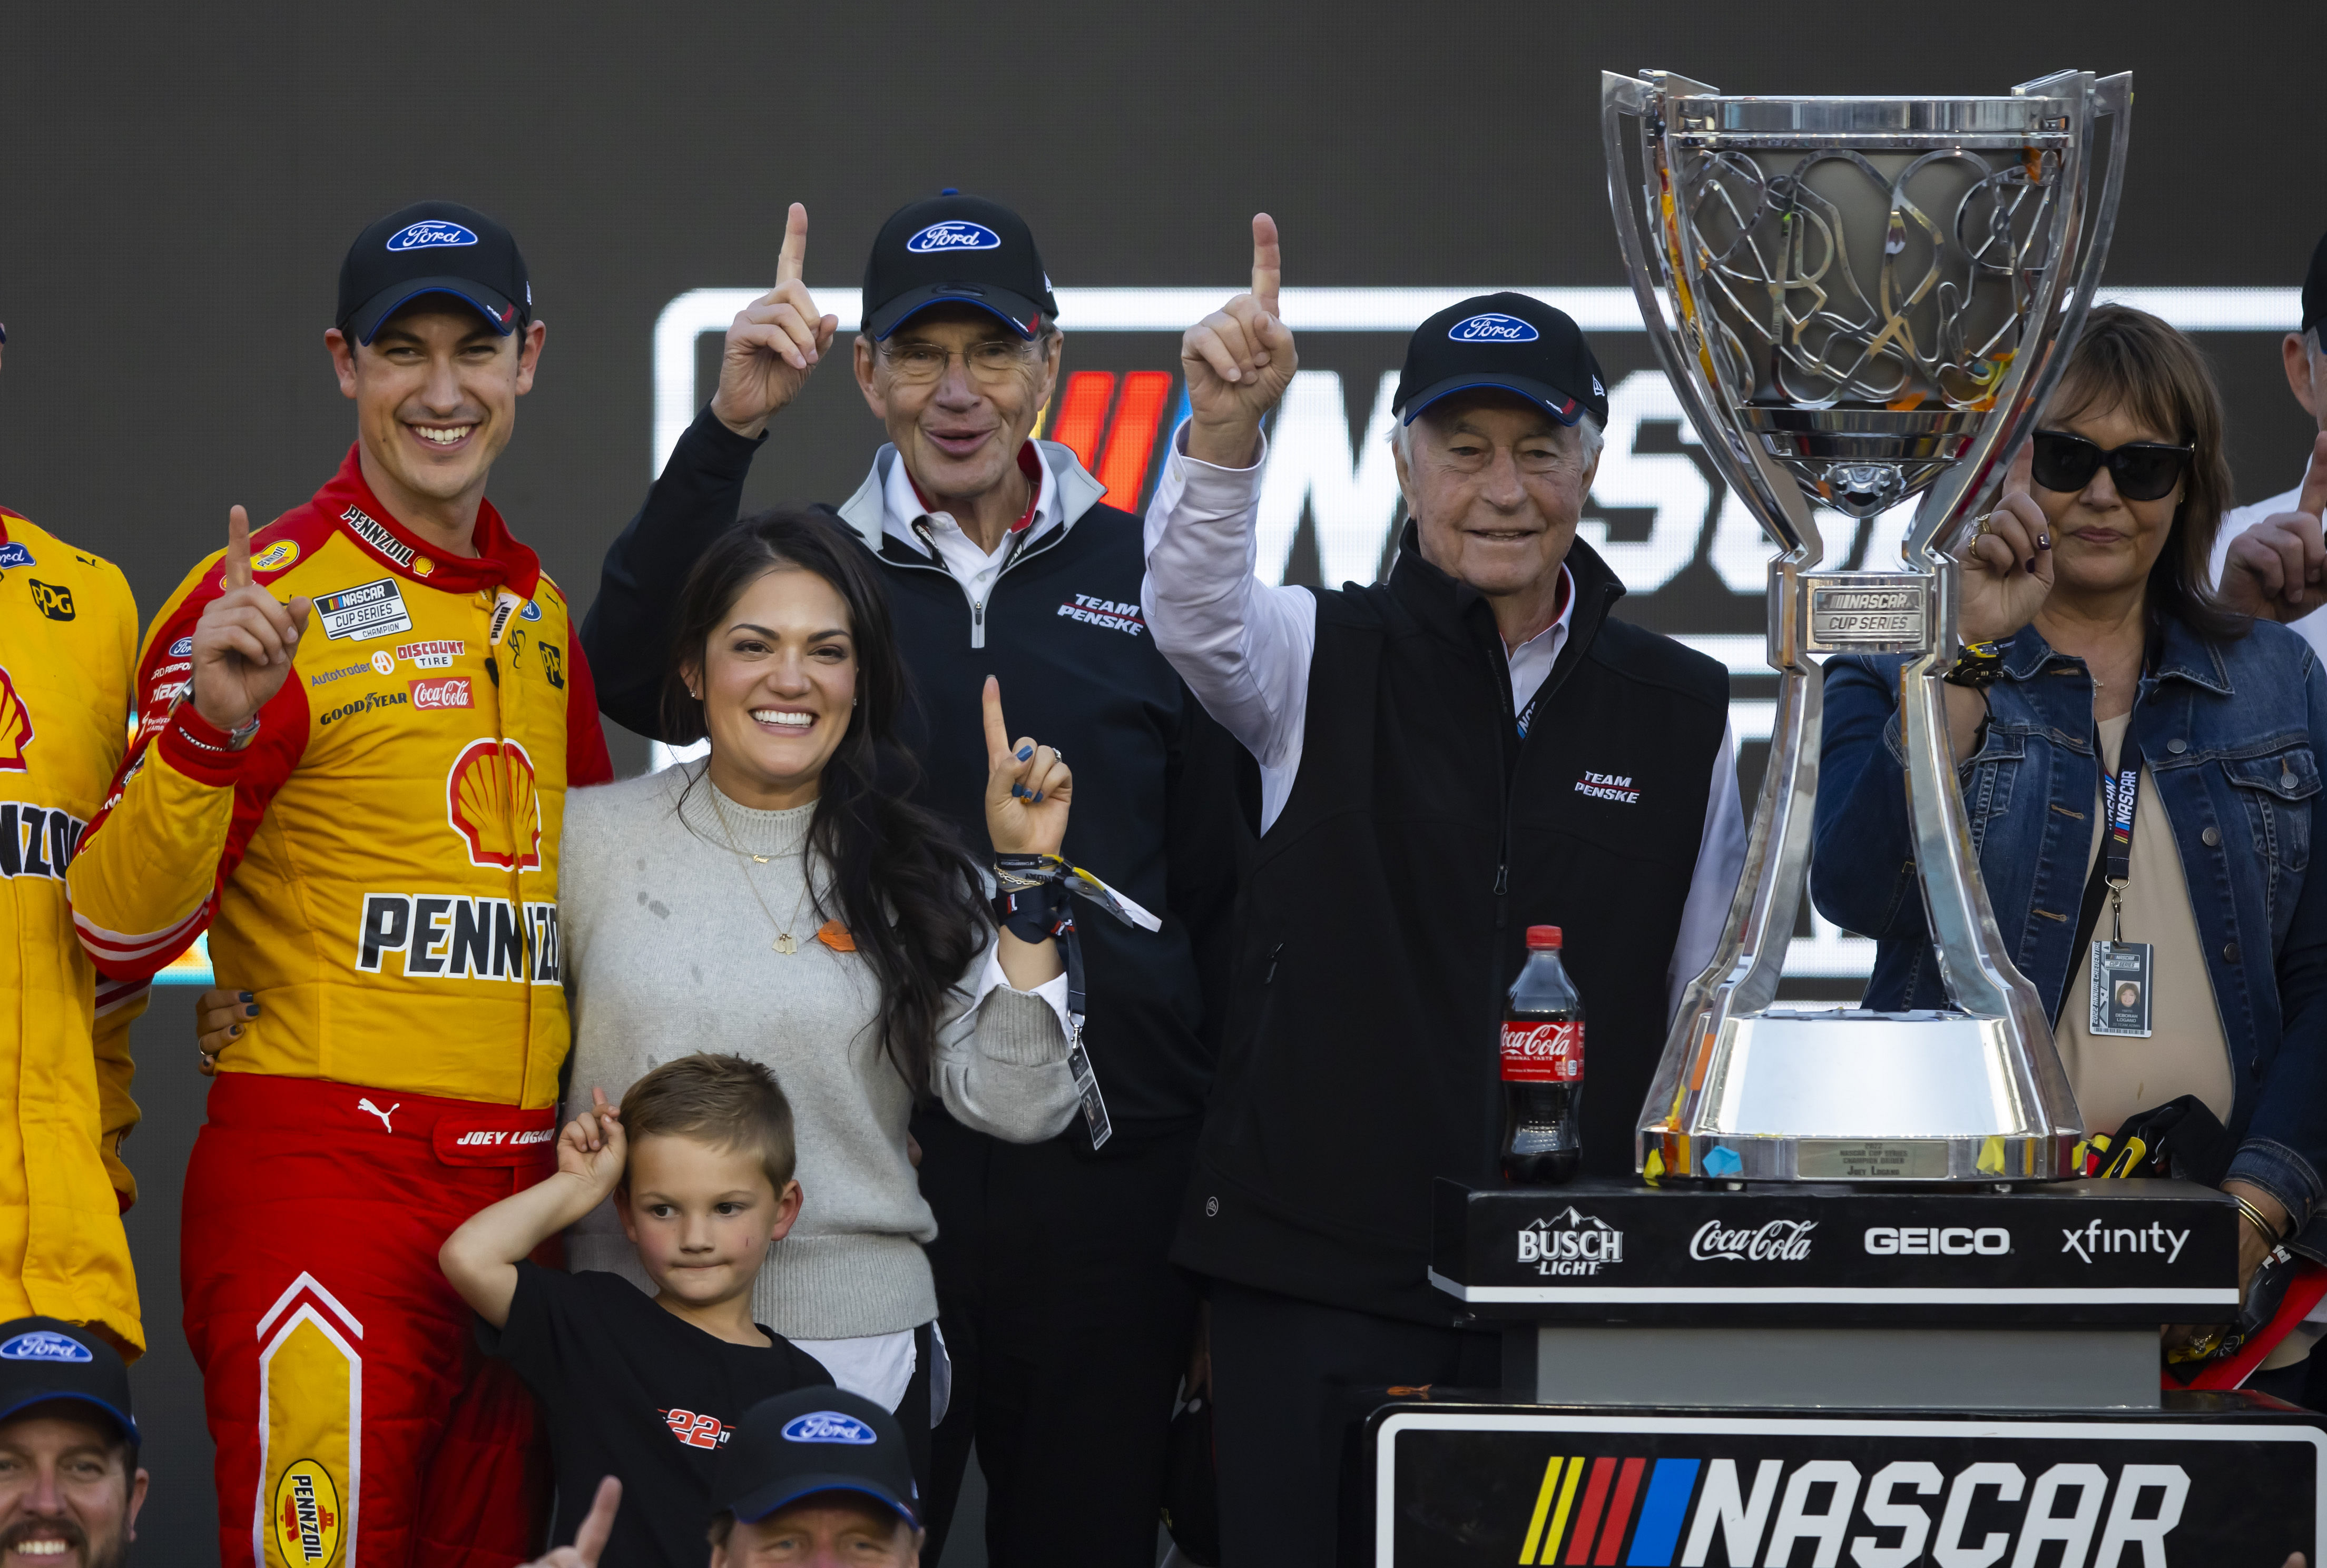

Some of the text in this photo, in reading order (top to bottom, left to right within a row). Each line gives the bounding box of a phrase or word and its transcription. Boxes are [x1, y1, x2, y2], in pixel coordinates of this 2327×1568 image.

[402, 224, 462, 247] Ford
[921, 226, 980, 249] Ford
[1464, 317, 1523, 338] Ford
[340, 504, 415, 568] PENNZOIL
[257, 546, 288, 568] PENNZOIL
[342, 585, 385, 607] NASCAR
[1076, 594, 1140, 617] TEAM
[1850, 593, 1908, 608] NASCAR
[336, 603, 392, 627] CUP SERIES
[490, 607, 511, 639] PUMA
[1057, 605, 1144, 636] PENSKE
[1829, 616, 1908, 629] CUP SERIES
[363, 623, 400, 637] CHAMPION
[396, 640, 465, 660] DISCOUNT
[419, 657, 448, 666] TIRE
[311, 662, 371, 687] Autotrader
[414, 681, 469, 708] Coca-Cola
[320, 692, 407, 725] GOODYEAR
[1585, 771, 1633, 787] TEAM
[1575, 782, 1640, 804] PENSKE
[2116, 771, 2136, 825] NASCAR
[457, 1131, 509, 1145] JOEY
[1517, 1230, 1623, 1263] BUSCH
[1690, 1220, 1819, 1260] Coca-Cola
[1864, 1228, 2010, 1255] GEICO
[2061, 1219, 2191, 1264] xfinity
[1539, 1261, 1600, 1275] LIGHT
[17, 1335, 76, 1357] Ford
[666, 1408, 722, 1450] 22
[800, 1415, 861, 1439] Ford
[290, 1474, 323, 1563] PENNZOIL
[1681, 1458, 2192, 1568] NASCAR
